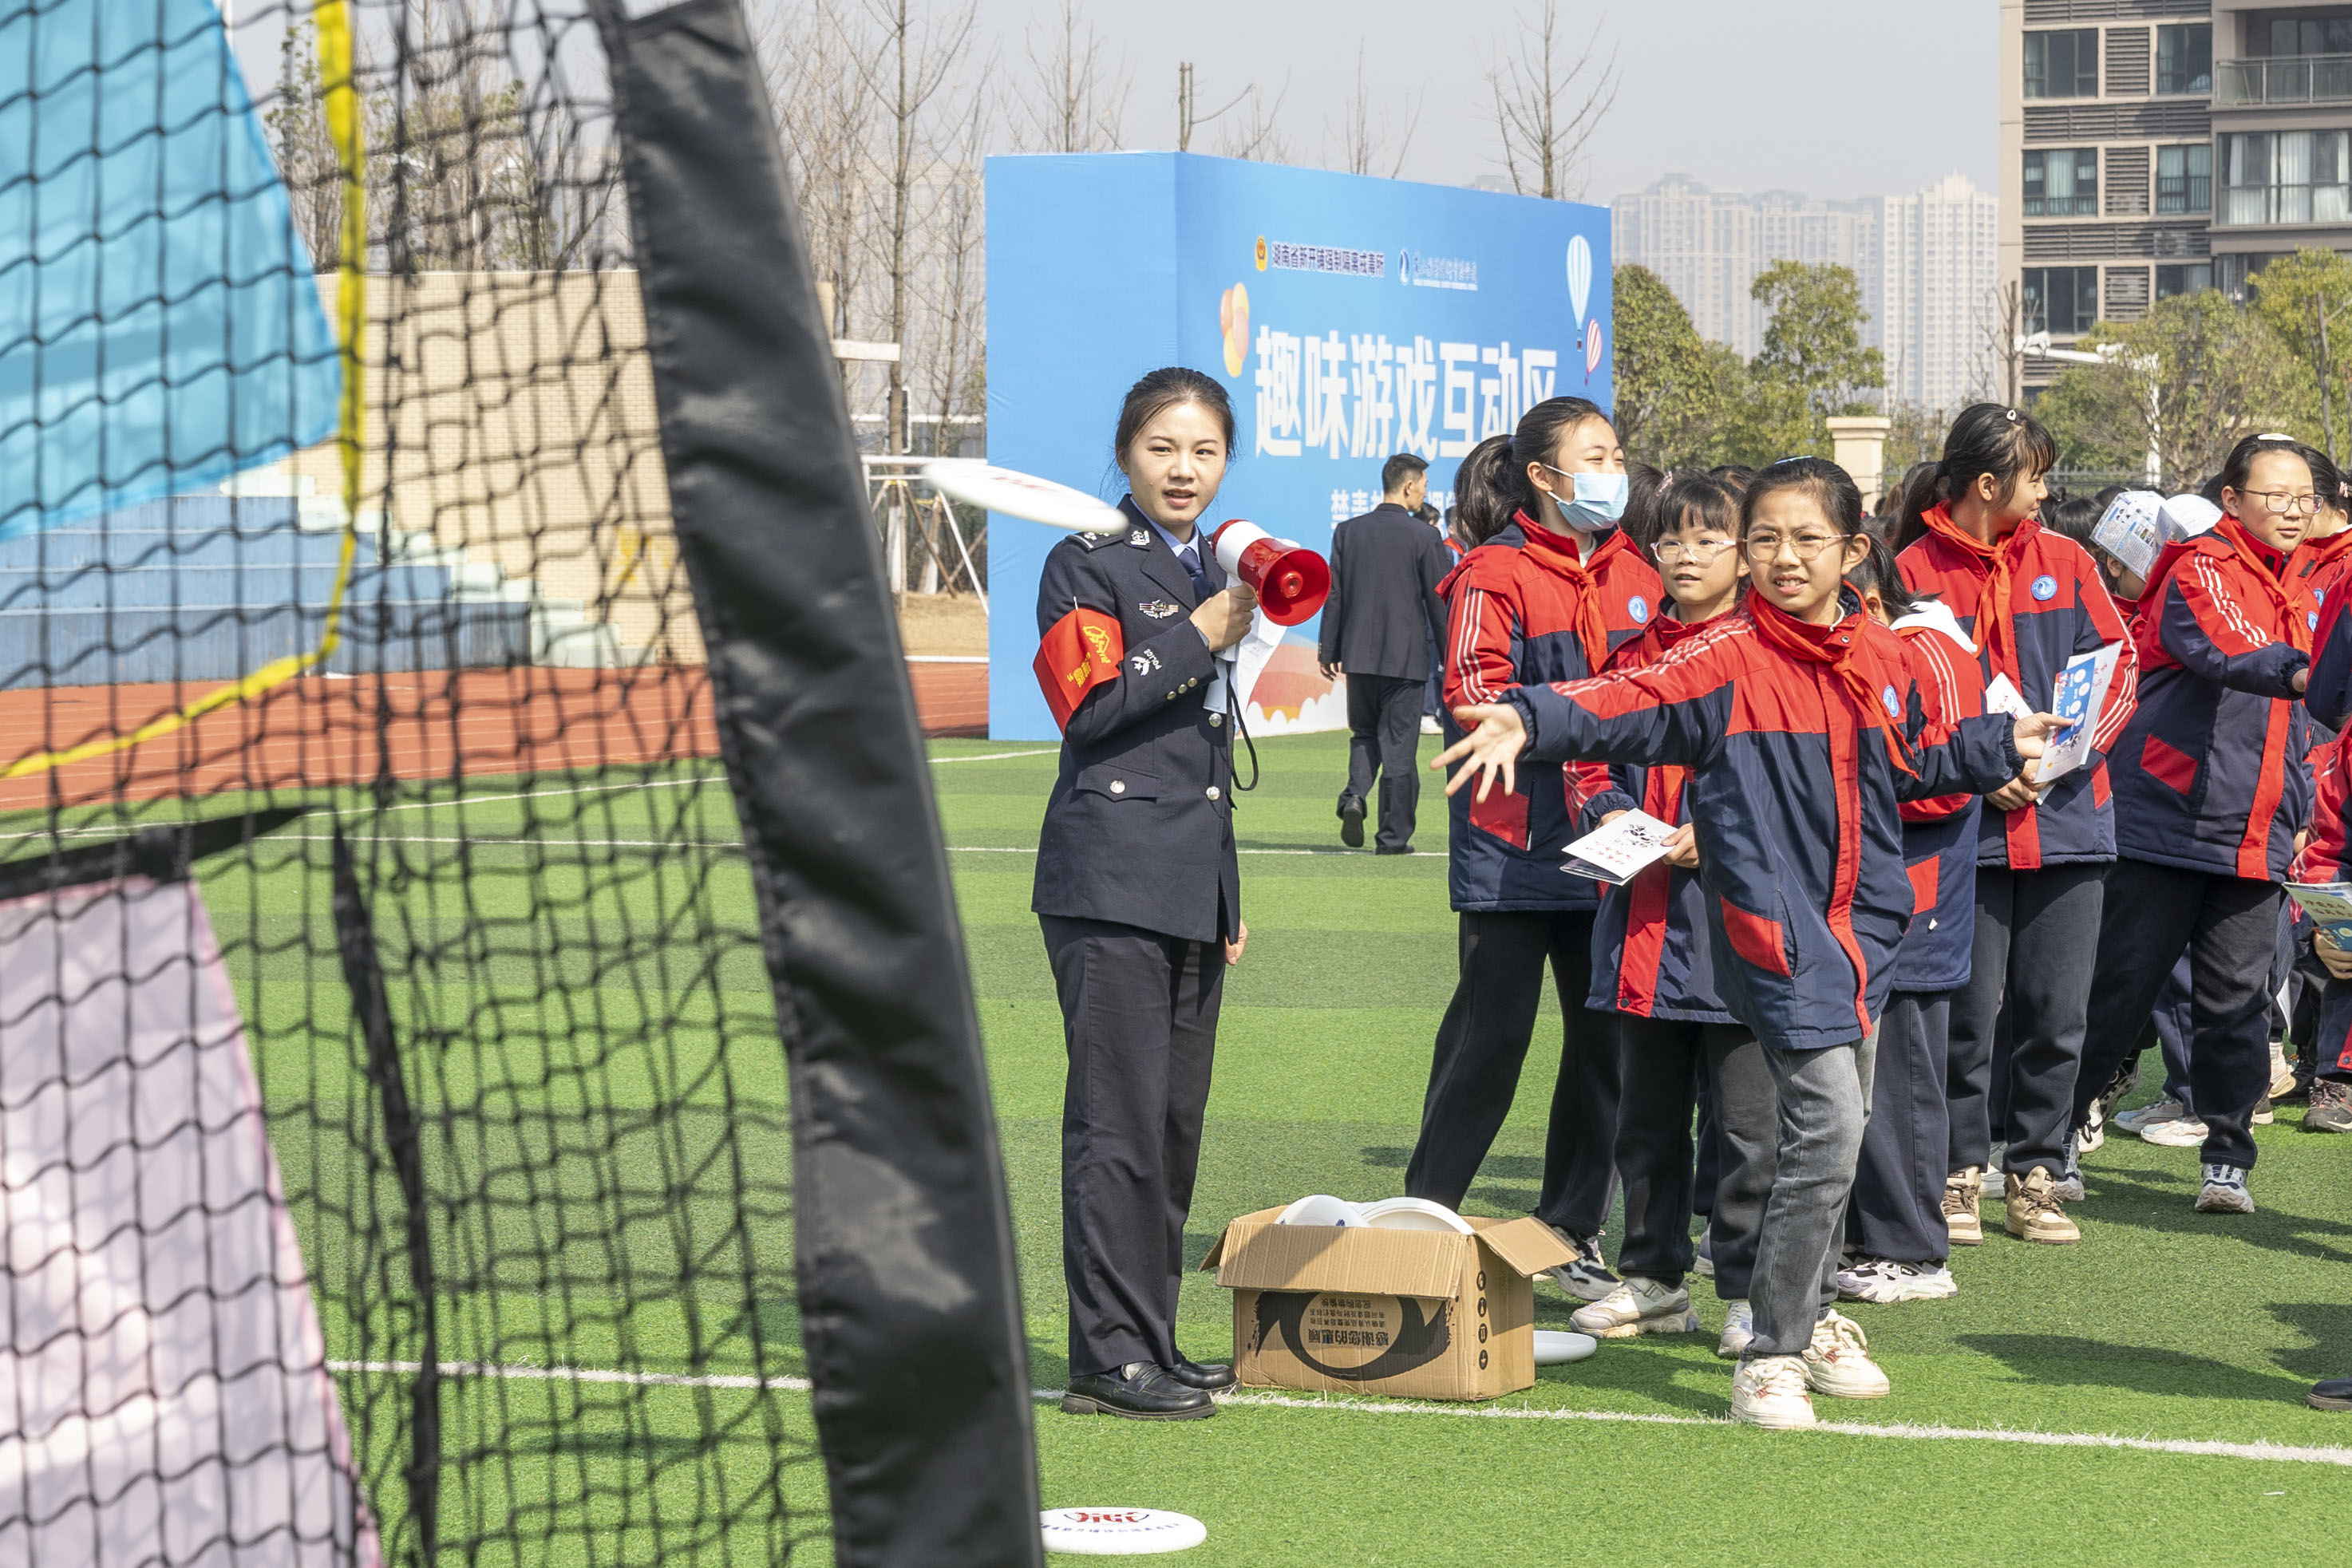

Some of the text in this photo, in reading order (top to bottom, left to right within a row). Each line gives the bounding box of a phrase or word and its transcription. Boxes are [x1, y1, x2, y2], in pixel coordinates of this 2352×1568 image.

[1255, 325, 1557, 461] 趣味游戏互动区
[1144, 649, 1162, 669] POLICE
[1322, 1297, 1371, 1309] 祝您购物愉快
[1308, 1329, 1388, 1345] 感谢您的惠顾
